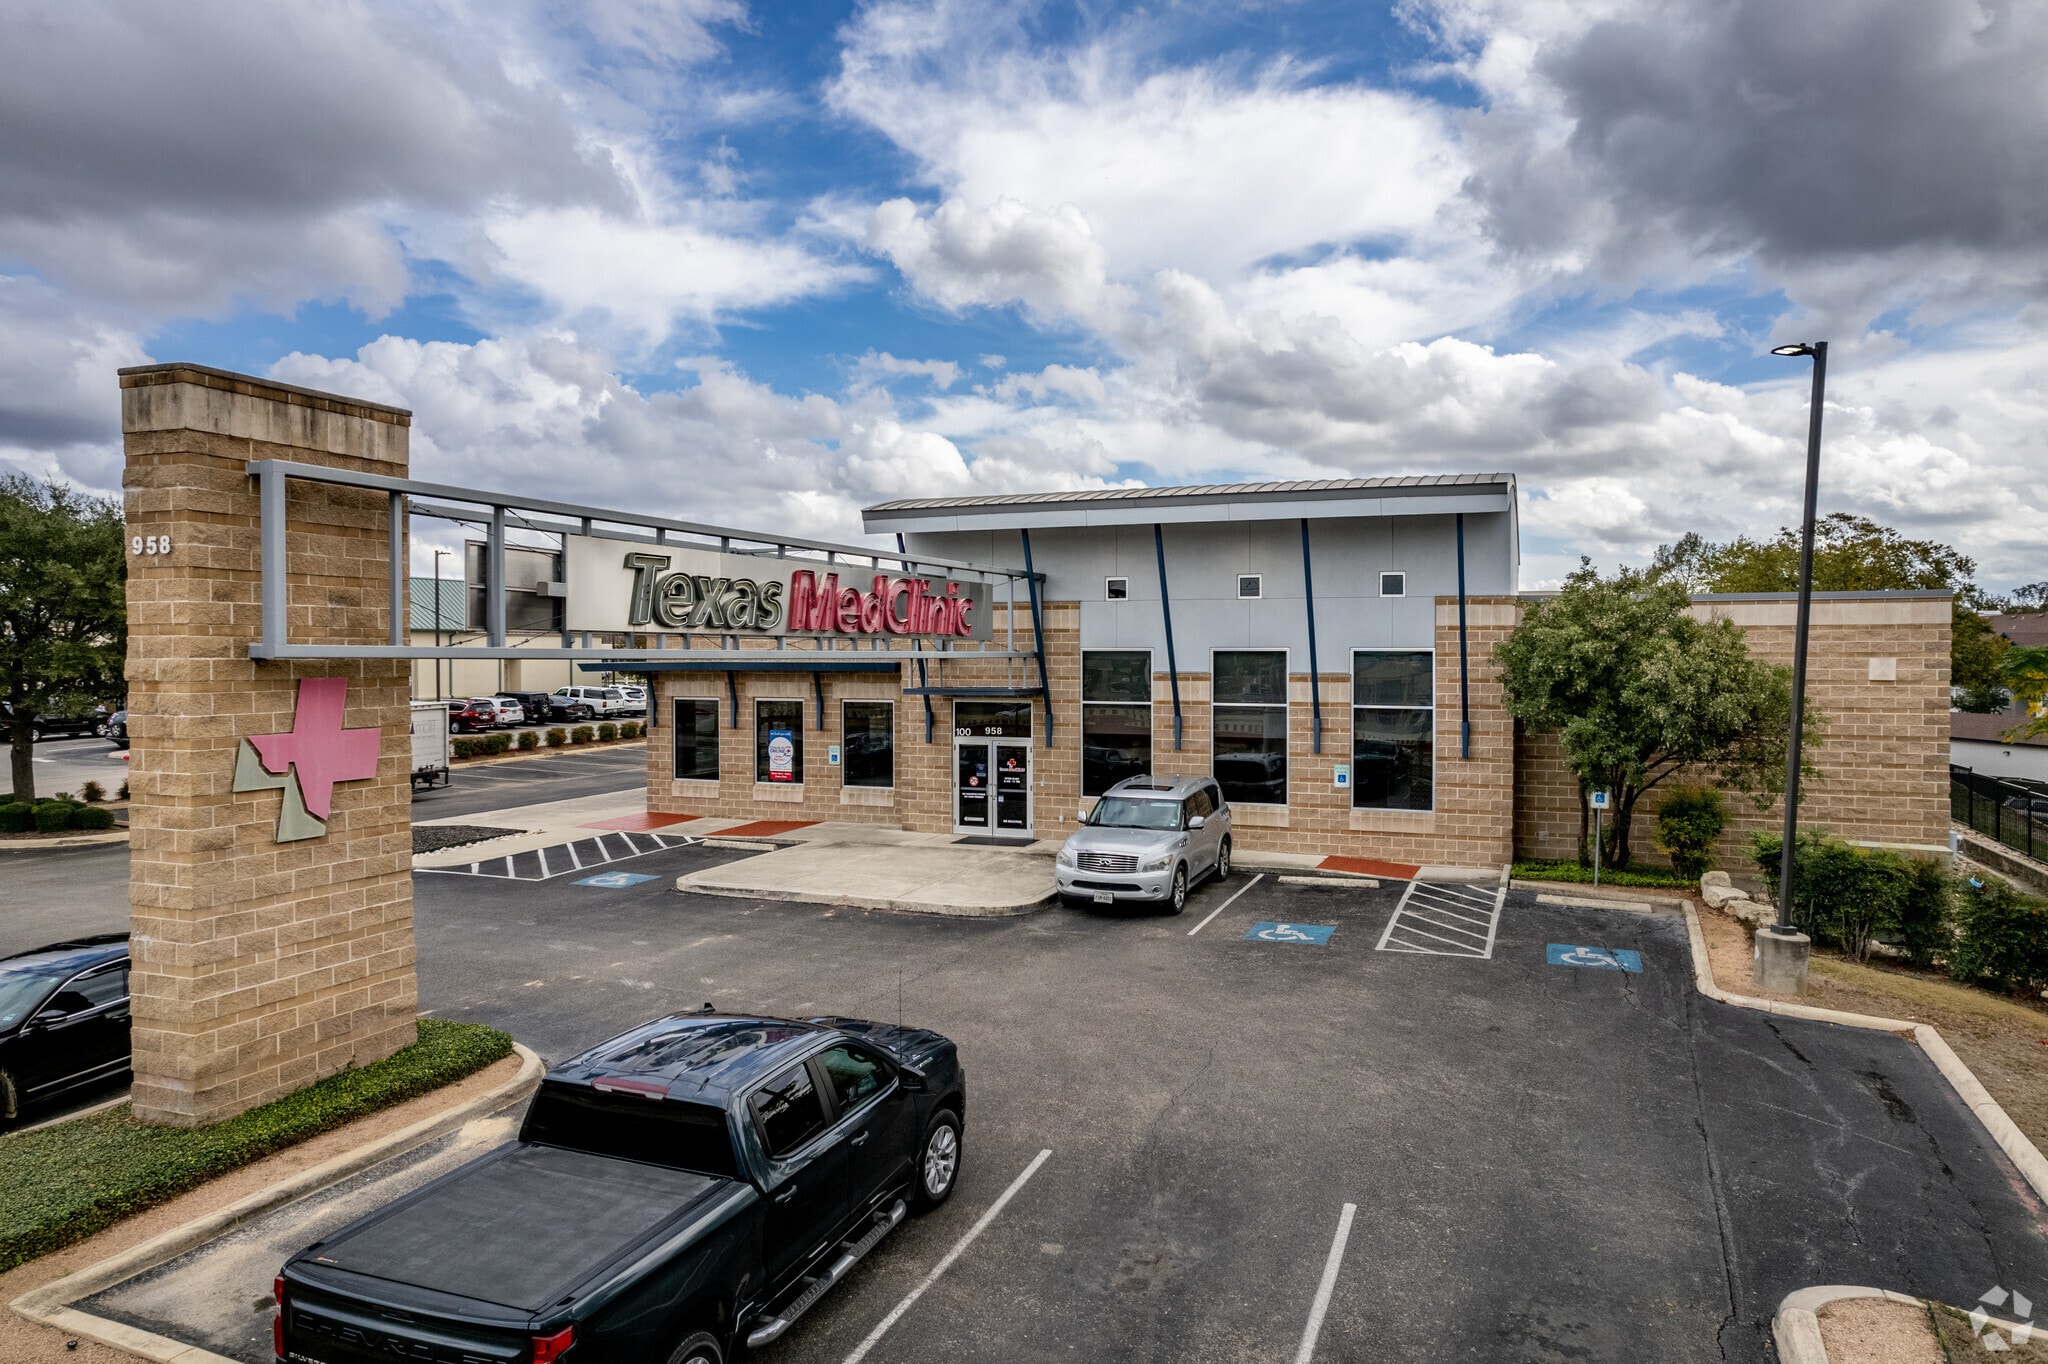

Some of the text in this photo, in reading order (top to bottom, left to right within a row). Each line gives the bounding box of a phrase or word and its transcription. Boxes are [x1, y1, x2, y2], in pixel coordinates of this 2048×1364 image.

[132, 535, 171, 555] 958
[623, 551, 974, 637] Texas MedClinic
[956, 727, 972, 736] 100
[984, 726, 1003, 735] 958
[297, 1314, 508, 1364] CHEVROLE
